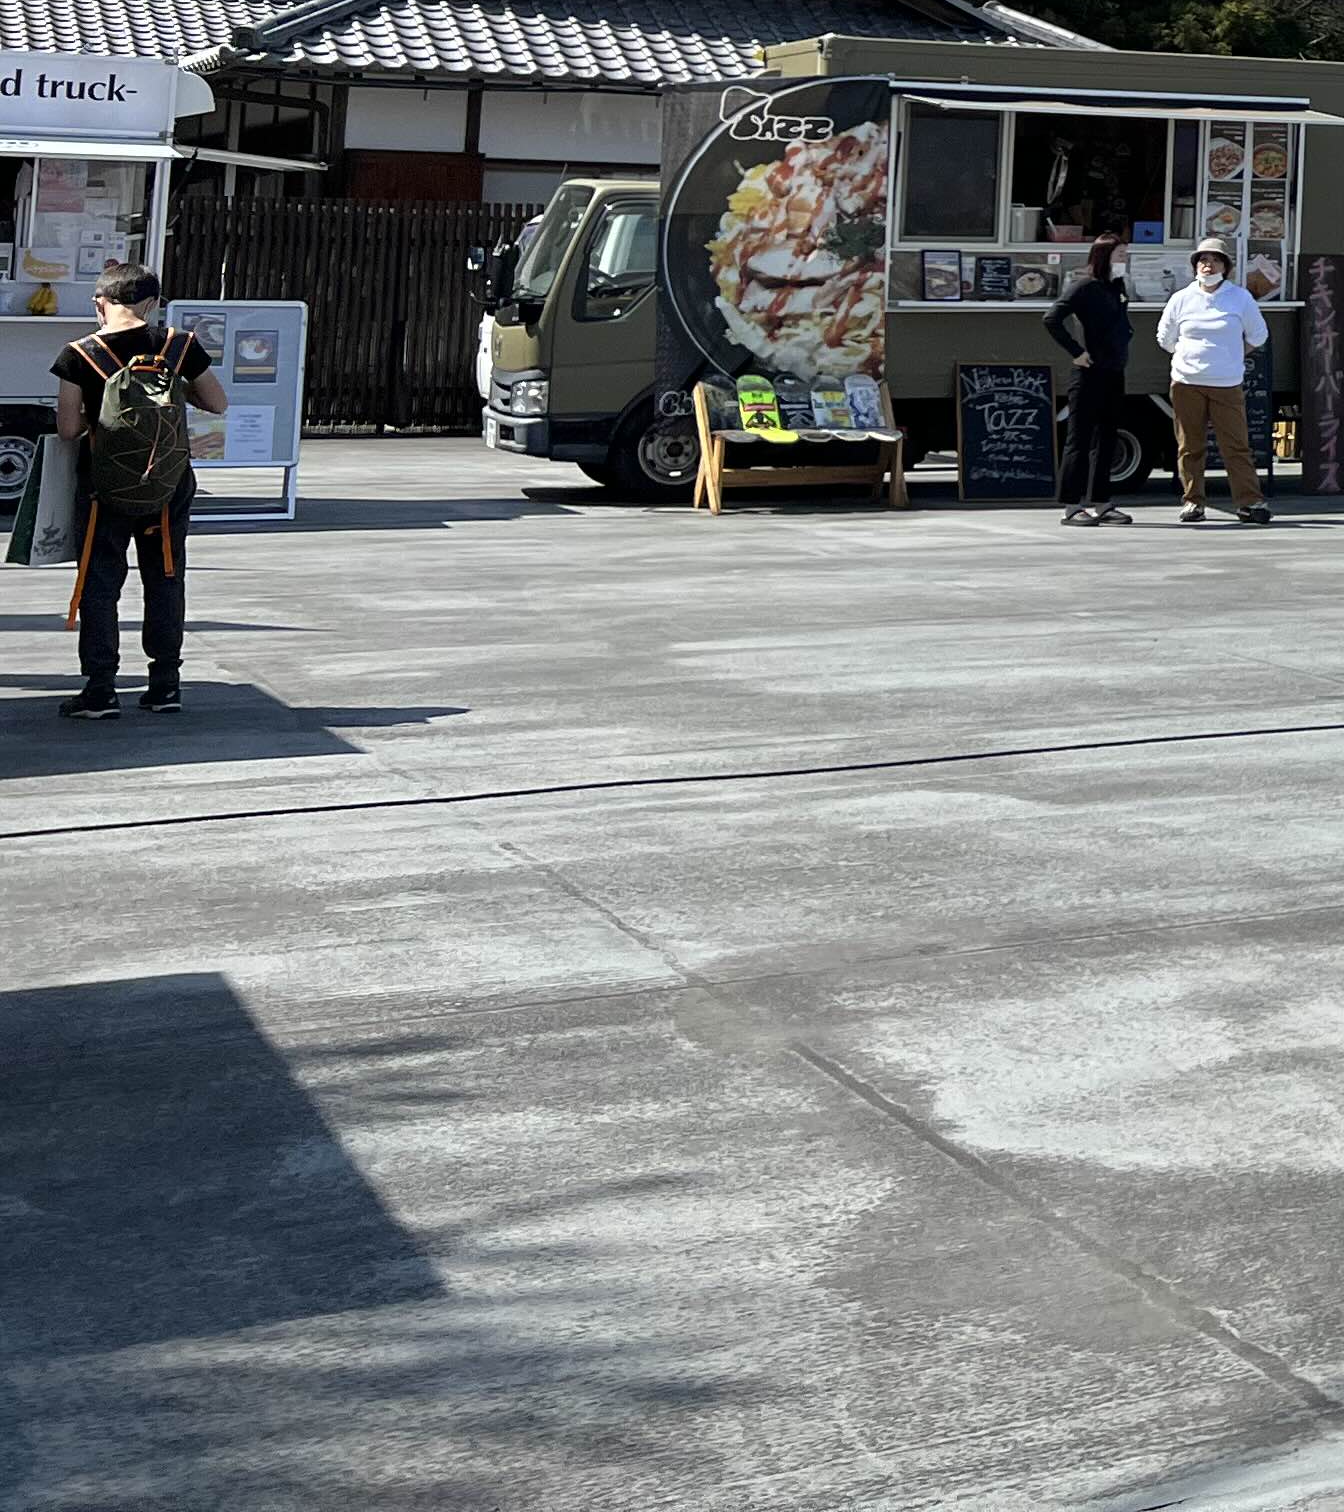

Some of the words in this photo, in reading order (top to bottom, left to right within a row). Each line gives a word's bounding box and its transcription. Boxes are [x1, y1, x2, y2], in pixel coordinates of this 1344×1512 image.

[36, 73, 138, 102] truck-
[1308, 256, 1344, 492] チキンオーバーライス
